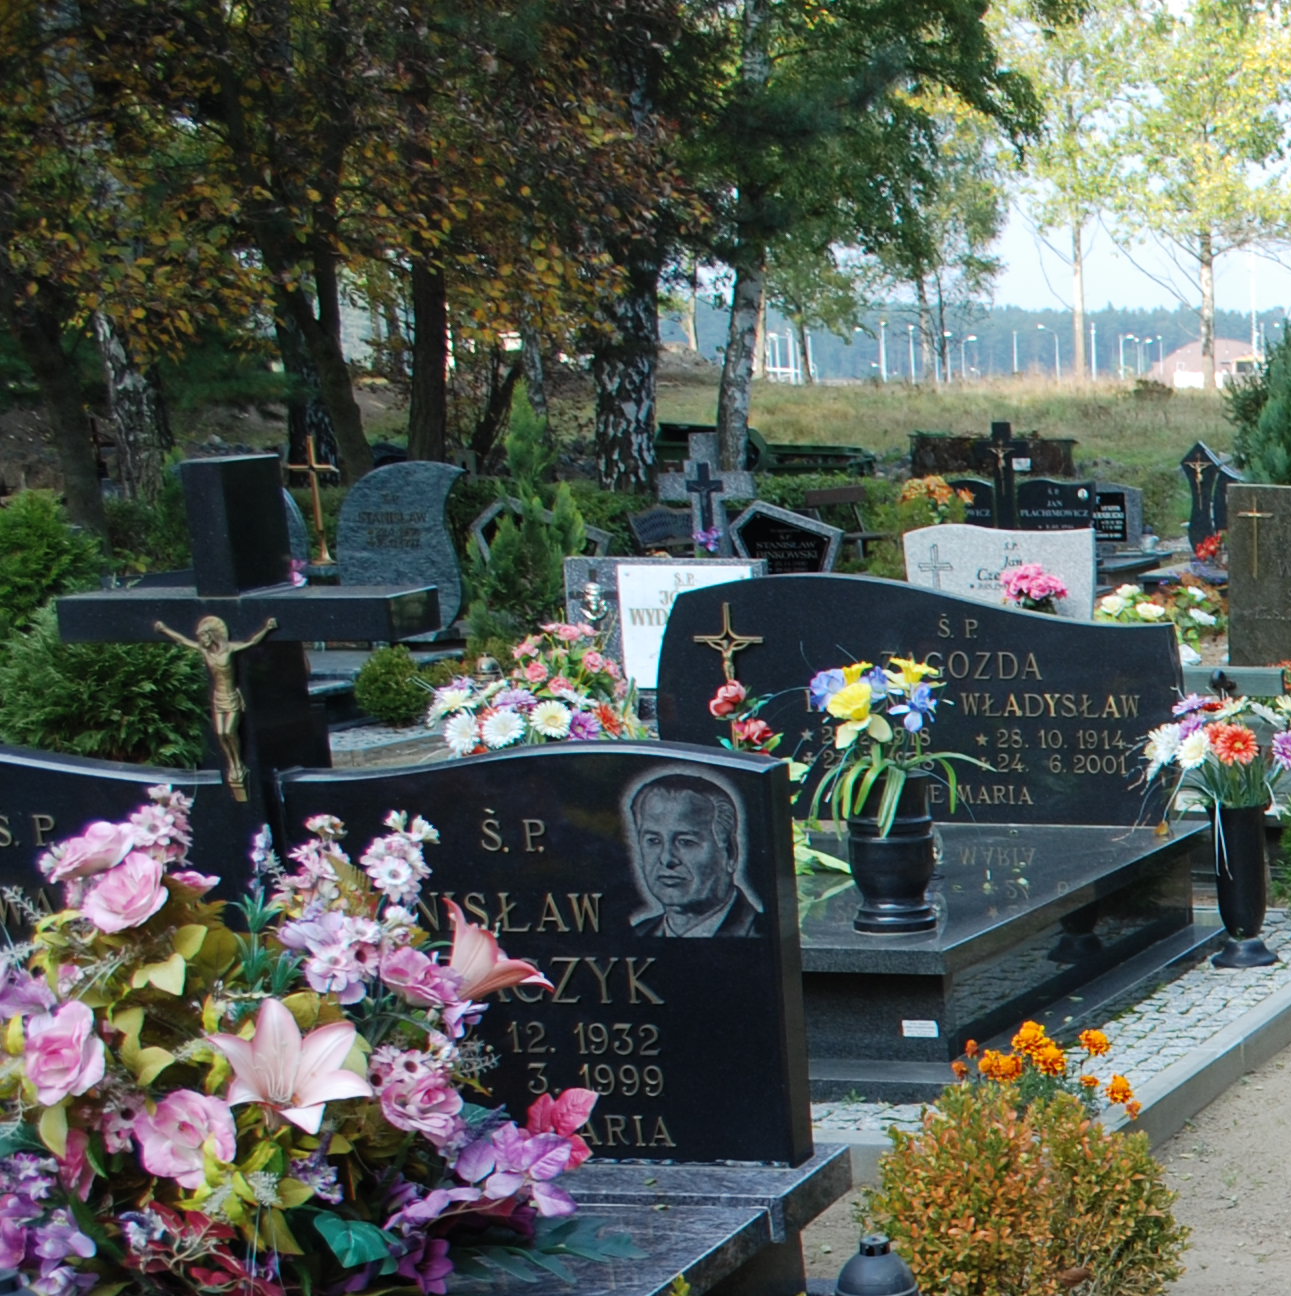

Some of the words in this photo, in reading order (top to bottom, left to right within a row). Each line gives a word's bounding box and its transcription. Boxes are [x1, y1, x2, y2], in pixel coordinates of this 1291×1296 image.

[880, 651, 1043, 681] ZGOZDA
[960, 693, 1140, 719] WŁADYSŁAW
[1077, 730, 1128, 750] 1914
[1073, 755, 1129, 775] 2001
[958, 784, 1034, 805] MARIA
[416, 891, 604, 933] NISŁAW
[573, 1021, 662, 1057] 1932
[578, 1063, 665, 1098] 1999
[577, 1114, 677, 1148] ARIA
